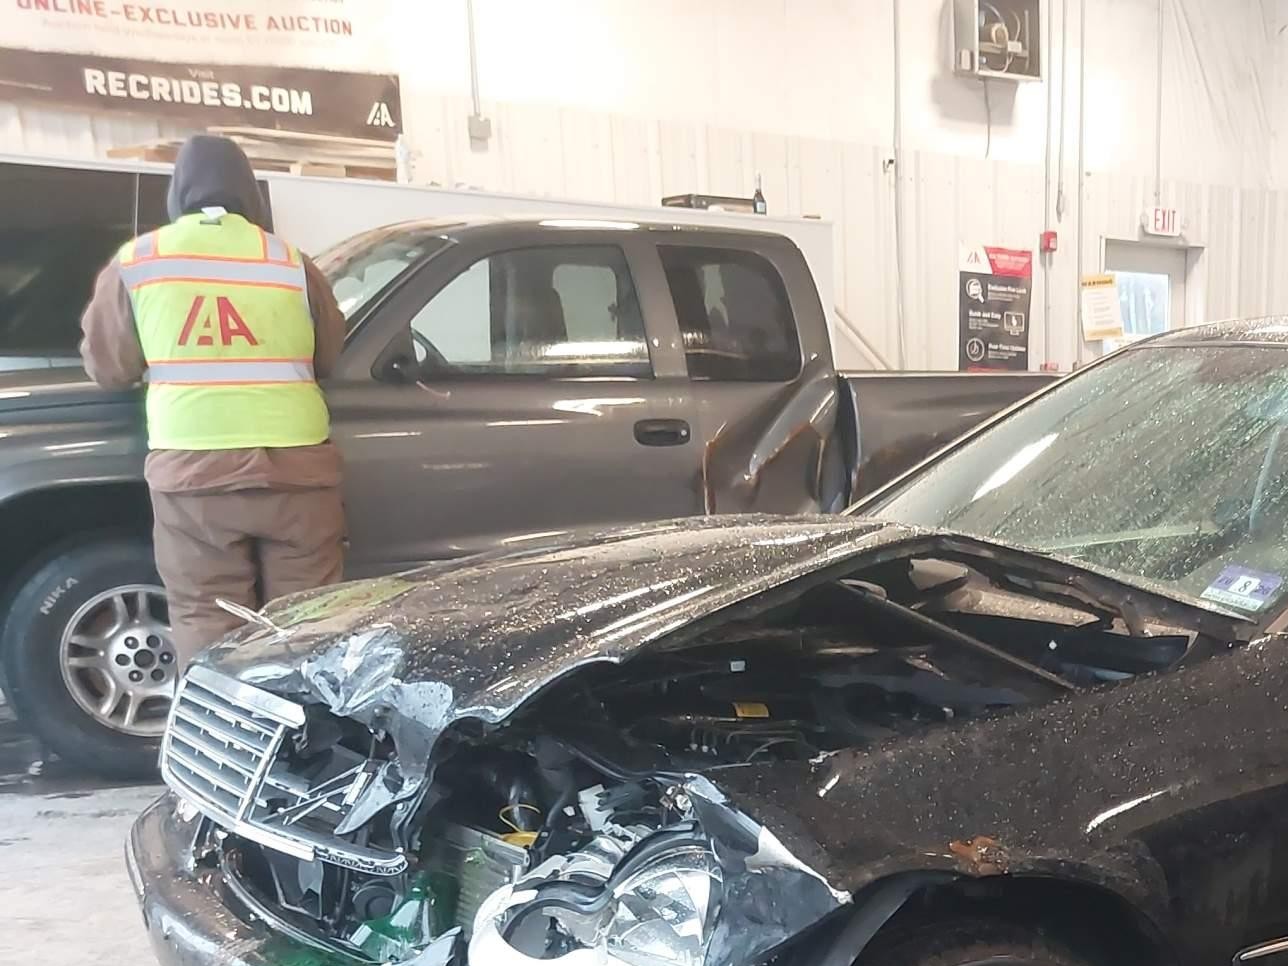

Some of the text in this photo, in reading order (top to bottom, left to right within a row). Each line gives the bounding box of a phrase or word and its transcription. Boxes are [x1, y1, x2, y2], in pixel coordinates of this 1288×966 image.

[266, 15, 353, 36] AUCTION
[188, 68, 215, 80] Visit
[84, 68, 313, 116] RECRIDES.COM
[1154, 208, 1177, 232] EXIT
[1238, 580, 1252, 593] 8
